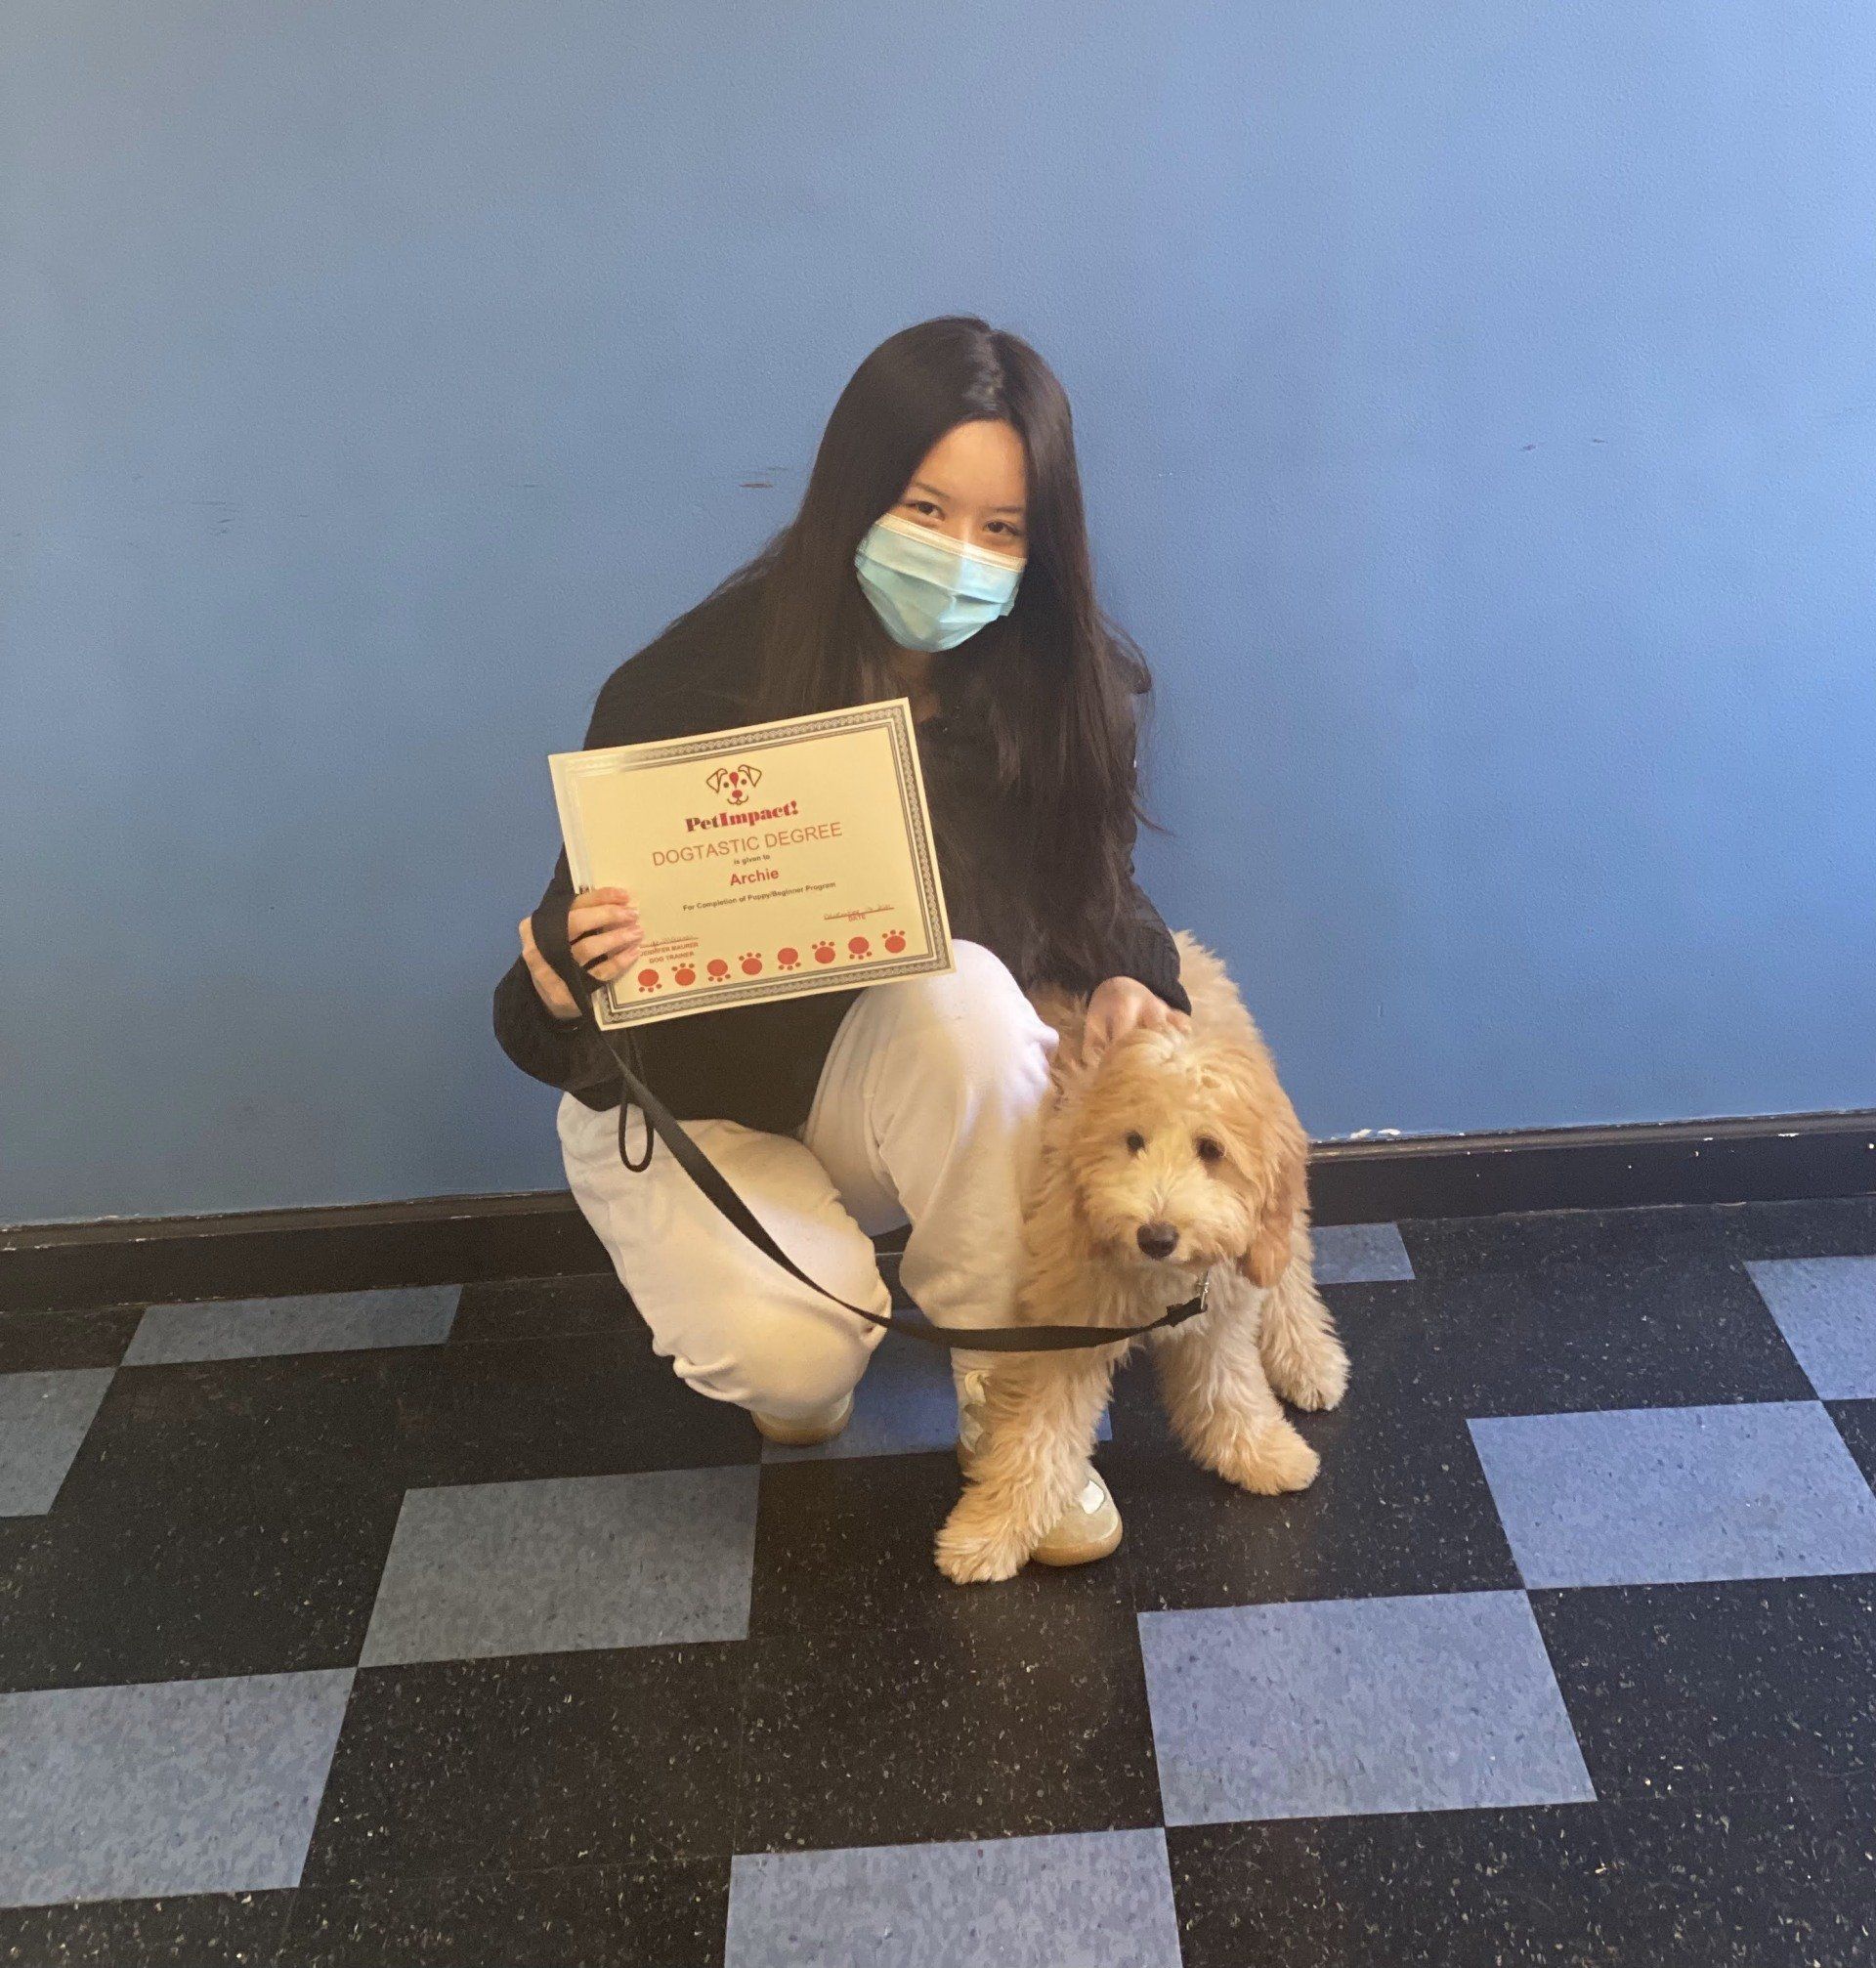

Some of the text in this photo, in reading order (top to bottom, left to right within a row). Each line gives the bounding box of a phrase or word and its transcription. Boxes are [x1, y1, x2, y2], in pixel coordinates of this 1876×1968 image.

[685, 800, 799, 833] PetImpact!
[652, 822, 843, 867] DOGTASTIC DEGREE
[742, 856, 762, 866] given
[730, 868, 780, 886] Archie
[697, 897, 737, 910] Completion
[805, 881, 836, 892] Program
[665, 951, 695, 961] TRAINER
